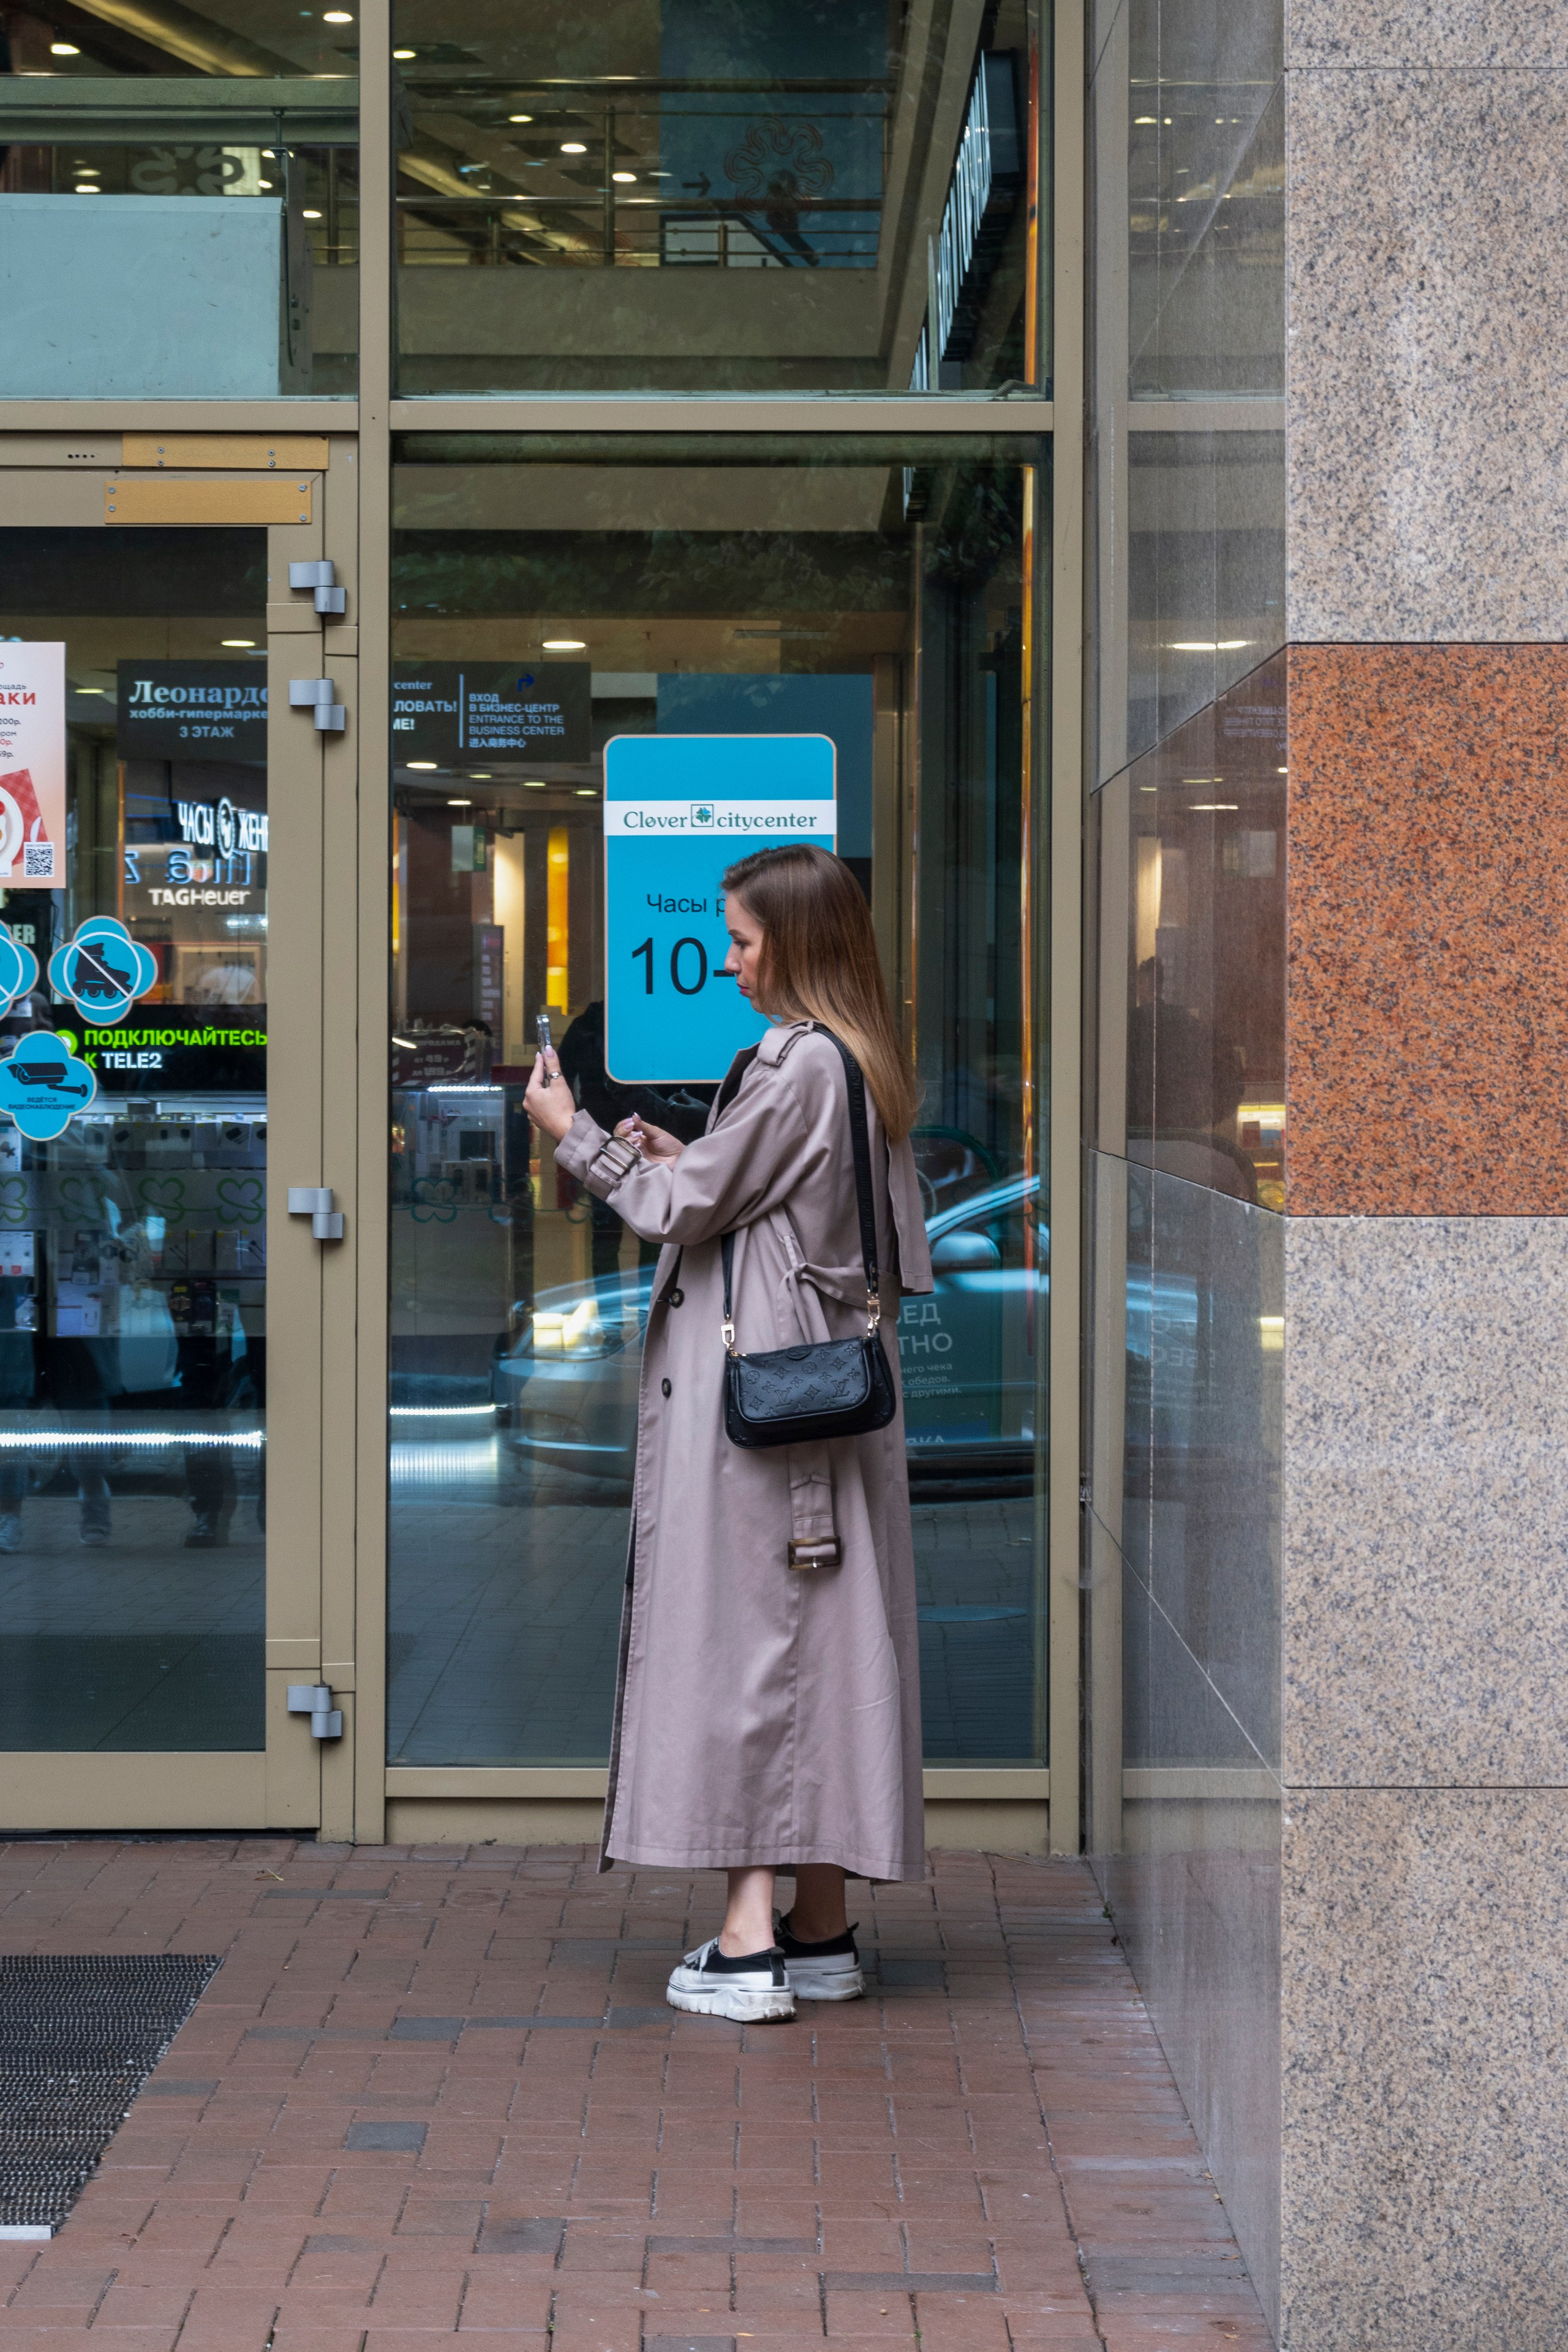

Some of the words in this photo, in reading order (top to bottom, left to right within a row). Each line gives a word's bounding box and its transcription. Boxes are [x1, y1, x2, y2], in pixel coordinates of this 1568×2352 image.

[469, 693, 499, 703] ВХОД
[479, 704, 560, 714] БИЗНЕС-ЦЕНТР
[469, 715, 524, 724] ENTRANCE
[527, 715, 541, 724] TO
[543, 715, 564, 724] THE
[179, 726, 188, 737] 3
[192, 726, 235, 738] ЭТАЖ
[469, 726, 520, 735] BUSINESS
[523, 726, 565, 735] CENTER
[178, 802, 214, 845] ЧАСЫ
[624, 812, 687, 828] Clover
[717, 811, 817, 831] citycenter
[647, 894, 707, 913] Часы
[85, 1026, 268, 1048] ПОДКЛЮЧАЙТЕСЬ
[85, 1053, 97, 1069] К
[102, 1052, 162, 1069] TELE2
[896, 1303, 941, 1327] ЕД
[908, 1376, 951, 1386] обедов.
[911, 1387, 962, 1399] другими.
